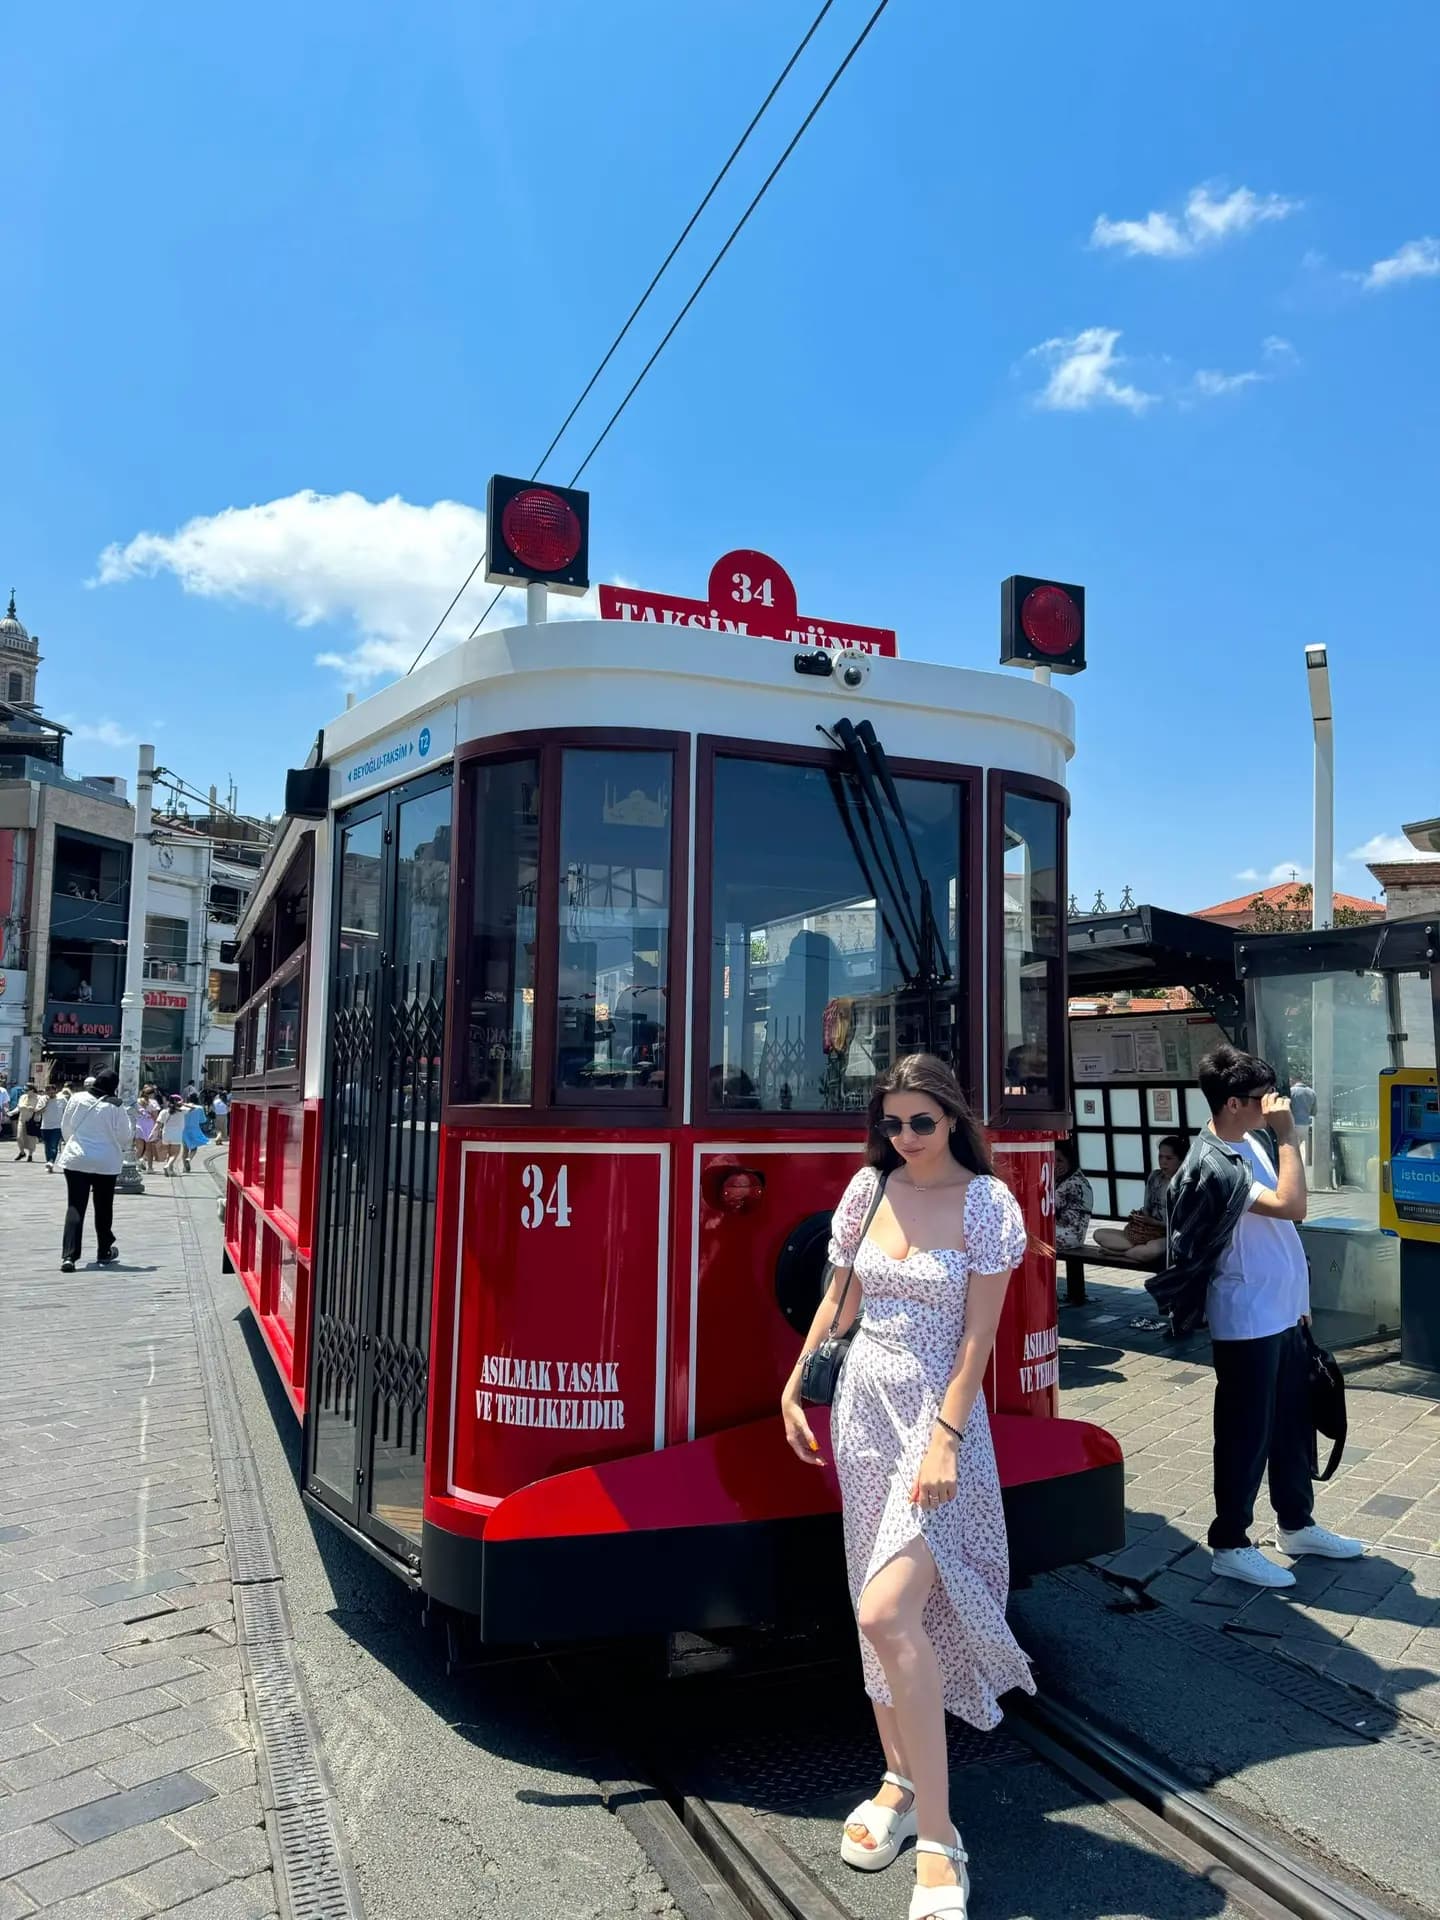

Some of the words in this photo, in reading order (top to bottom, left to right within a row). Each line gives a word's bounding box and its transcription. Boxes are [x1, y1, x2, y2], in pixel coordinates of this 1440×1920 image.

[731, 573, 775, 607] 34
[420, 735, 429, 749] T2
[143, 991, 187, 1008] ehlivan
[520, 1164, 572, 1229] 34
[1023, 1324, 1059, 1361] ASILMA
[480, 1355, 551, 1391] ASILMAK
[556, 1361, 619, 1393] YASAK
[1019, 1366, 1033, 1394] VE
[475, 1389, 492, 1421] VE
[495, 1393, 626, 1430] TEHLIKELIDIR
